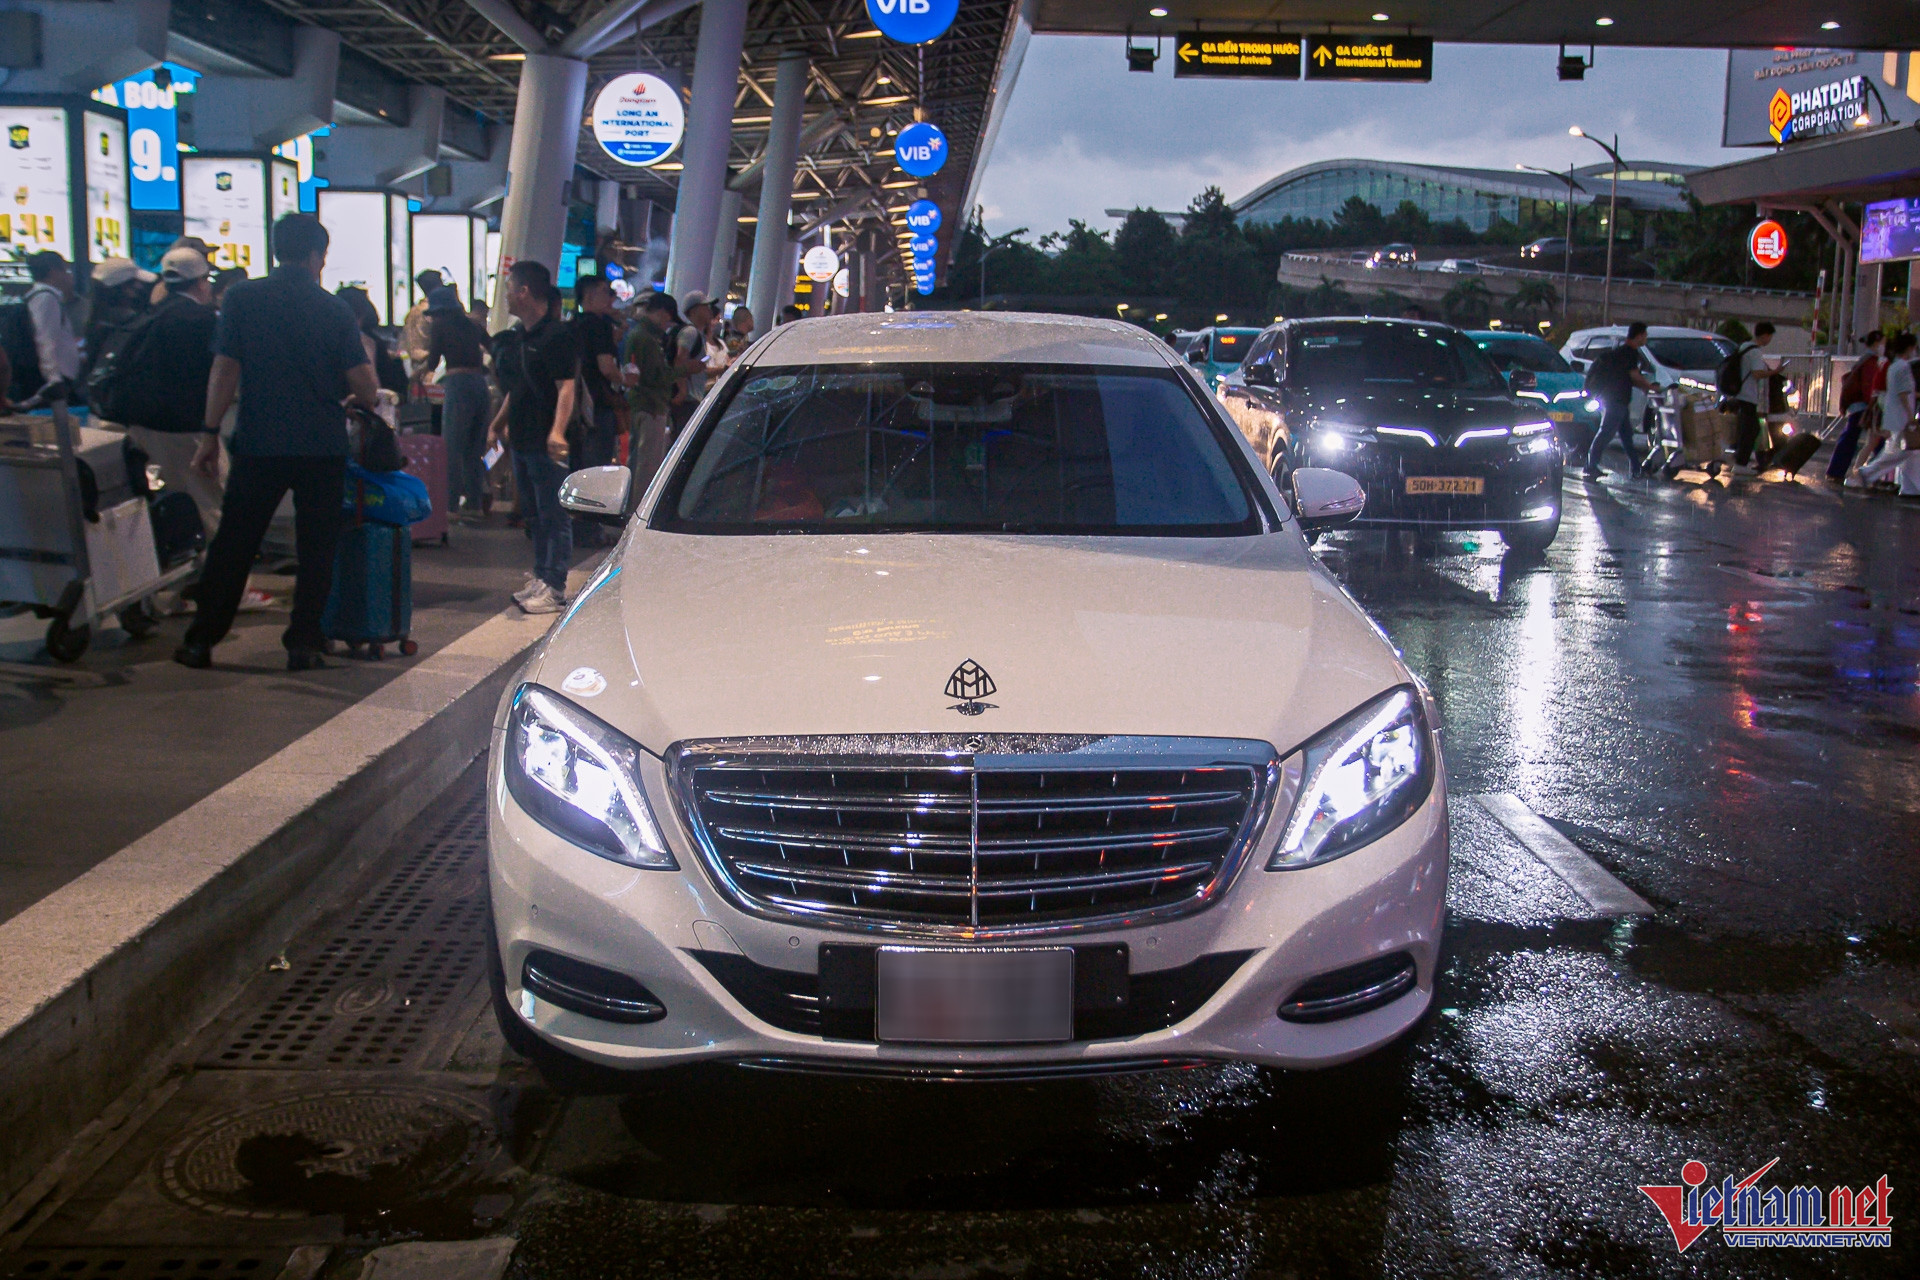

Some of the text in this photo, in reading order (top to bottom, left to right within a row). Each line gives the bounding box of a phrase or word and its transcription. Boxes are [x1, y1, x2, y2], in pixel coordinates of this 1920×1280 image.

[877, 0, 930, 14] VIB
[1202, 40, 1300, 55] GA ĐẾN TRONG NƯỚC
[1336, 44, 1393, 57] GA QUỐC TẾ
[1202, 54, 1273, 66] Domestic Arrivals
[1336, 57, 1422, 68] International Terminal
[1792, 75, 1862, 115] PHATDAT
[1792, 102, 1862, 132] CORPORATION
[899, 146, 931, 161] VIB
[908, 215, 931, 226] VIB
[911, 242, 929, 252] VIB
